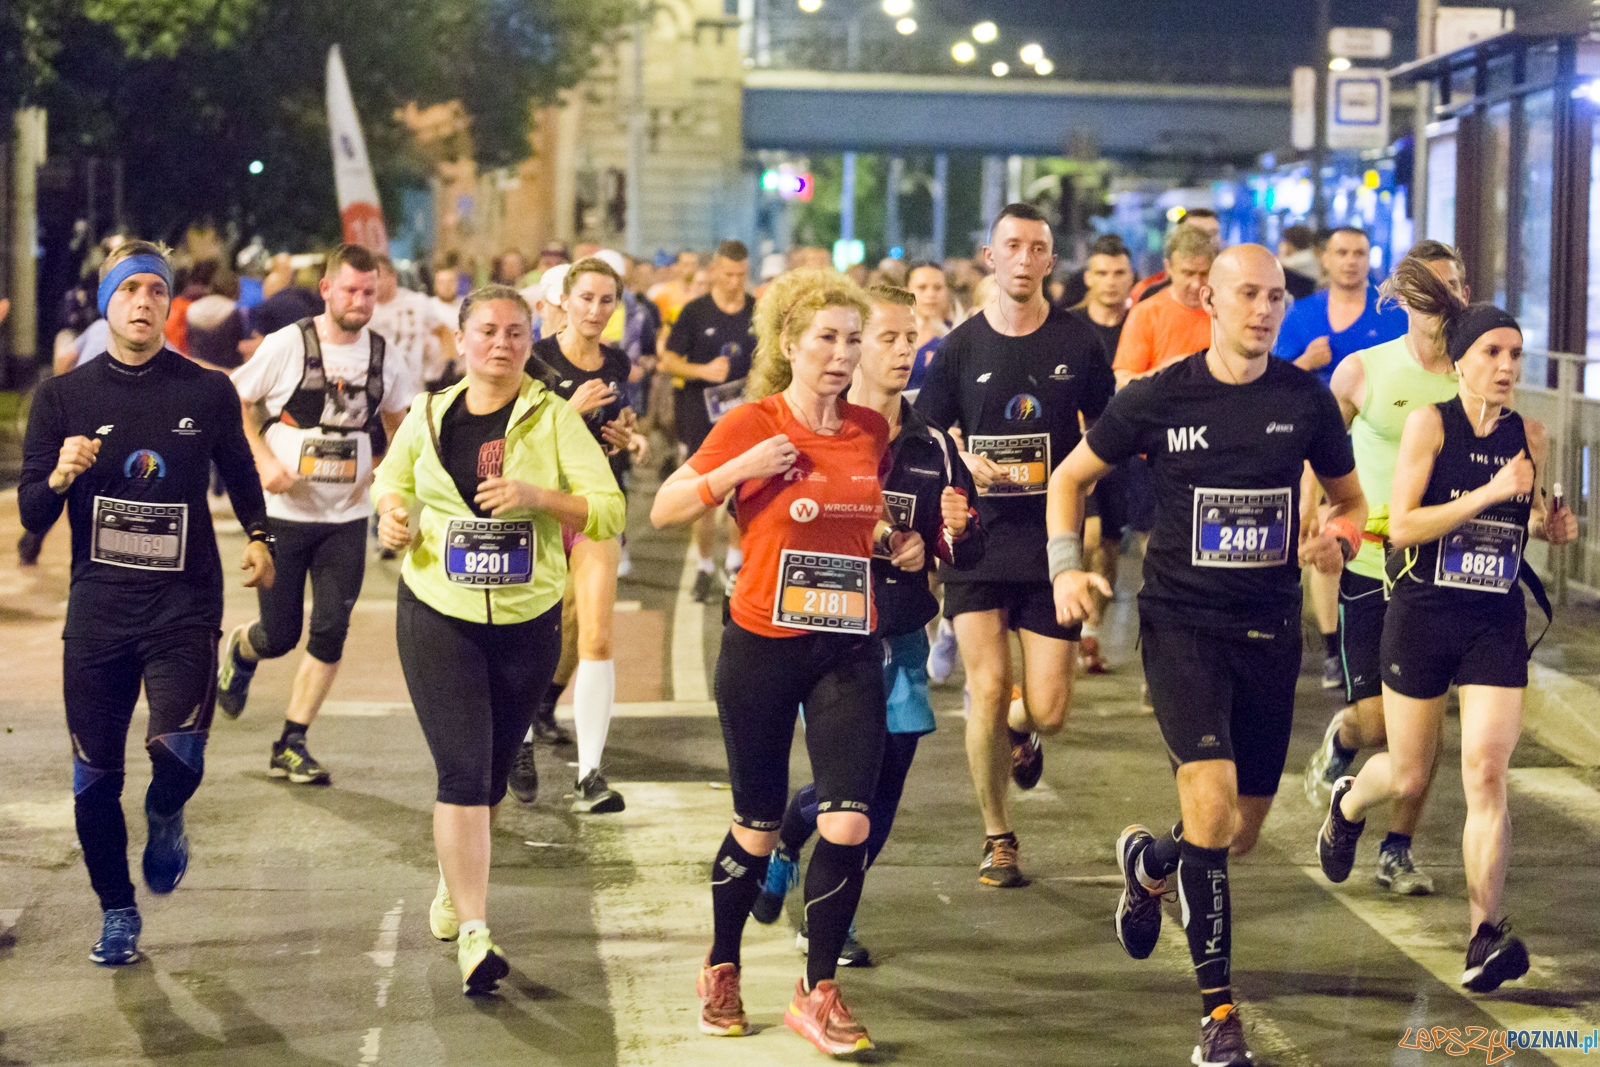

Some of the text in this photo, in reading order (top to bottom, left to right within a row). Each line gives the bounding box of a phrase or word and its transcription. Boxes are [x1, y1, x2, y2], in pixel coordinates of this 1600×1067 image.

[1167, 425, 1209, 453] MK
[480, 451, 504, 463] LOV
[1470, 453, 1488, 465] THE
[824, 503, 873, 513] WROCŁAW
[114, 532, 164, 556] 11169
[1219, 526, 1269, 551] 2487
[465, 551, 509, 573] 9201
[1461, 552, 1504, 577] 8621
[803, 590, 847, 615] 2181
[1205, 869, 1226, 954] Kalenji
